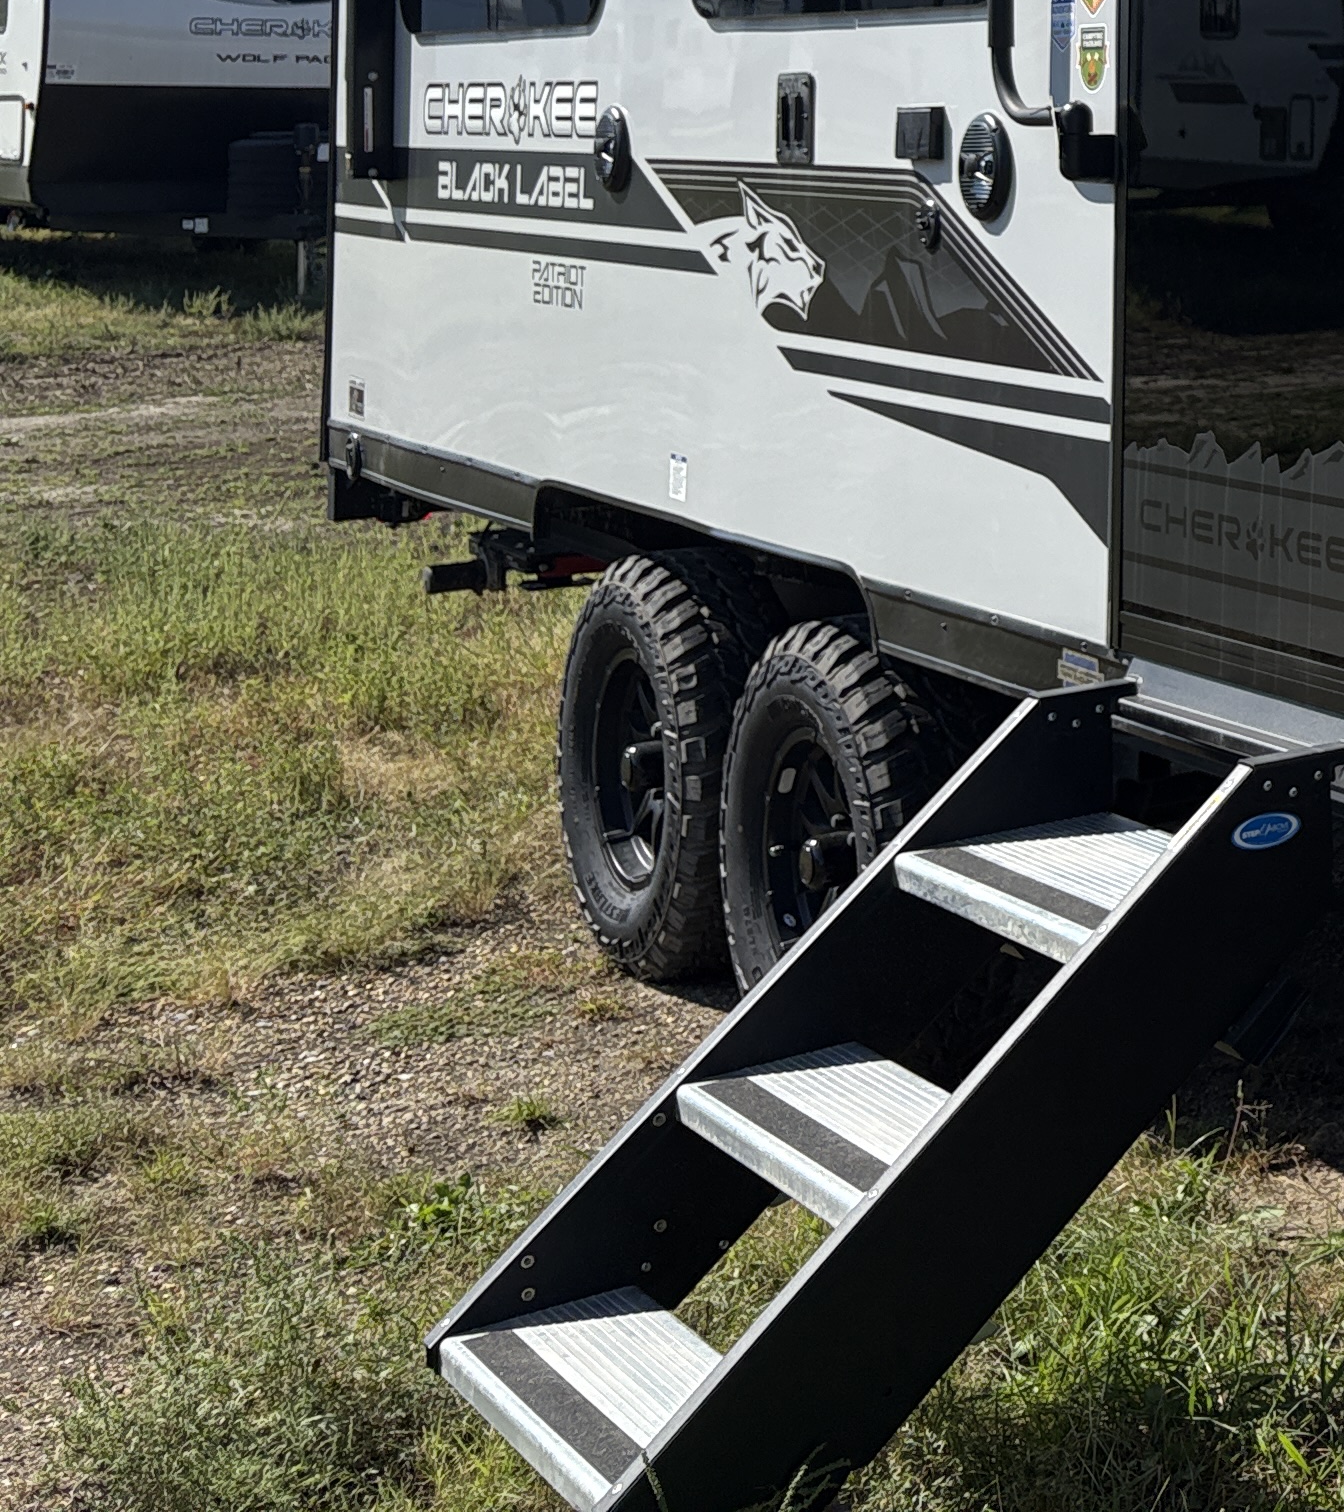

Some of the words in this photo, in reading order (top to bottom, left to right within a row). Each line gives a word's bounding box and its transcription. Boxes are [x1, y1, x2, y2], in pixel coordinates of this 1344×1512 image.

[189, 17, 331, 38] CHEROK
[216, 53, 287, 64] WOLF
[295, 53, 331, 64] PAC
[438, 161, 510, 204] BLACK
[515, 164, 594, 210] LABEL
[531, 260, 586, 288] PATRIOT
[533, 283, 583, 310] EDITION
